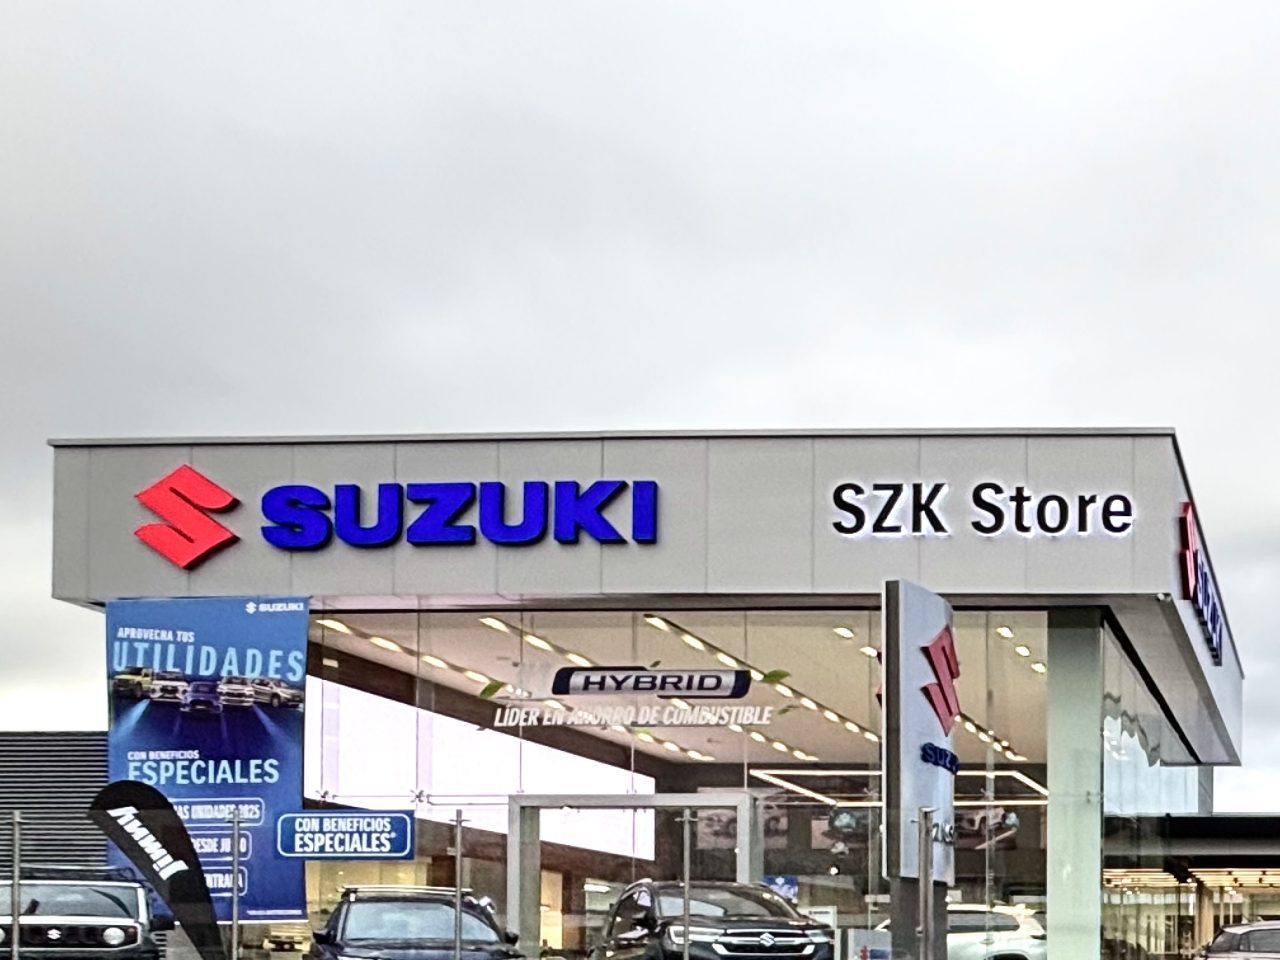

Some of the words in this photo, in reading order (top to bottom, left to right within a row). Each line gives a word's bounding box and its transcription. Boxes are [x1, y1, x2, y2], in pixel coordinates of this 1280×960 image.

[260, 480, 659, 552] SUZUKI
[832, 482, 949, 535] SZK
[970, 482, 1133, 534] Store
[258, 603, 304, 612] SUZUKI
[117, 627, 173, 642] APROVECHA
[176, 631, 195, 643] TUS
[113, 641, 304, 682] UTILIDADES
[582, 674, 723, 692] HYBRID
[494, 704, 539, 727] LÍDER
[542, 707, 565, 726] EN
[637, 705, 659, 725] DE
[663, 705, 774, 726] COMBUSTIBLE
[127, 759, 280, 786] ESPECIALES
[294, 818, 320, 832] CON
[322, 818, 392, 832] BENEFICIOS
